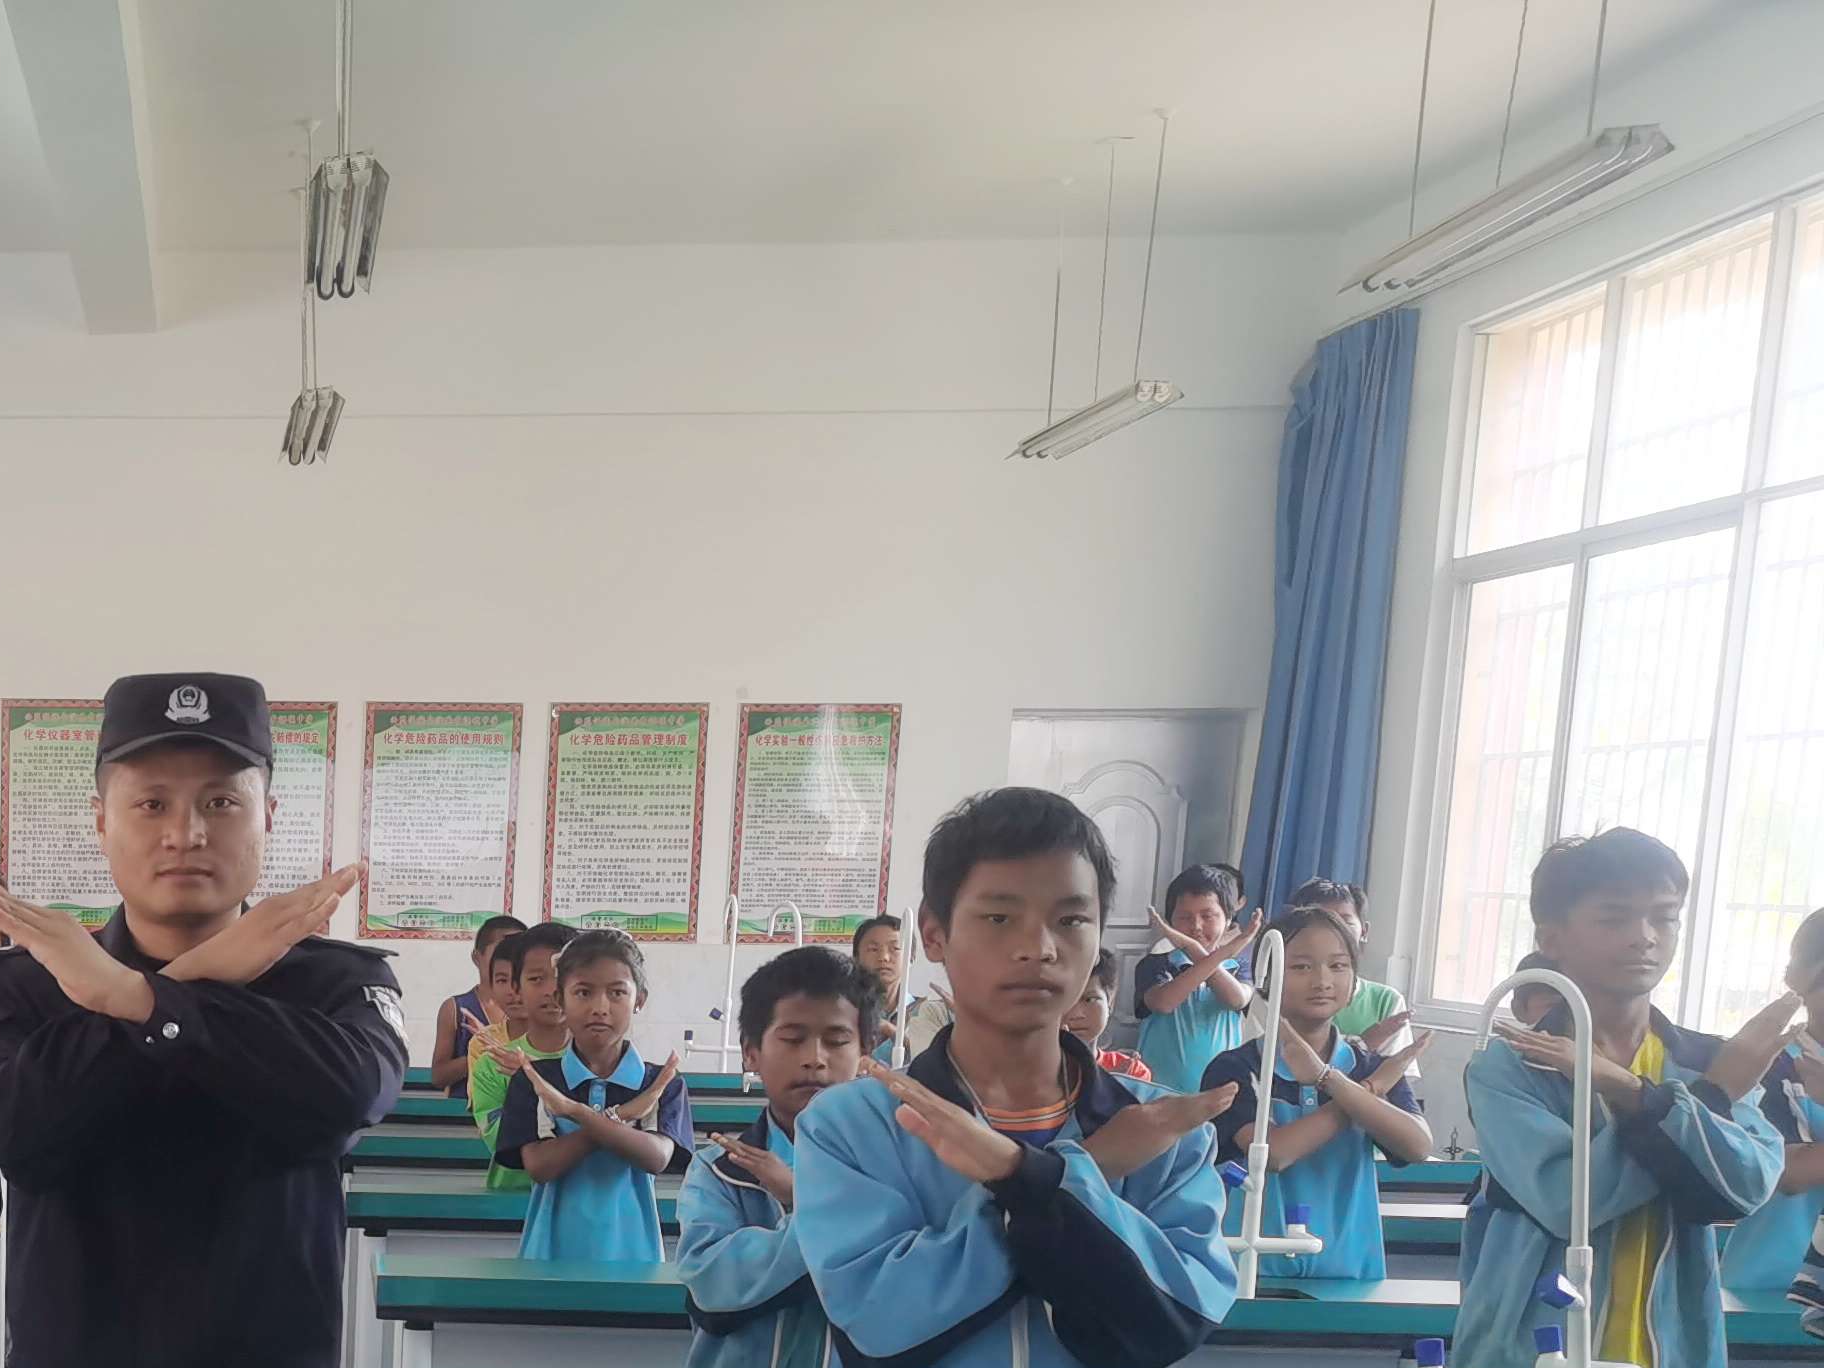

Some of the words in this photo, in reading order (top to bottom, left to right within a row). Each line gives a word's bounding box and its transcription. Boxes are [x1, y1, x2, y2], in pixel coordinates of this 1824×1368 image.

[384, 732, 504, 746] 化学危险药品的使用规则
[570, 733, 688, 747] 化学危险药品管理制度
